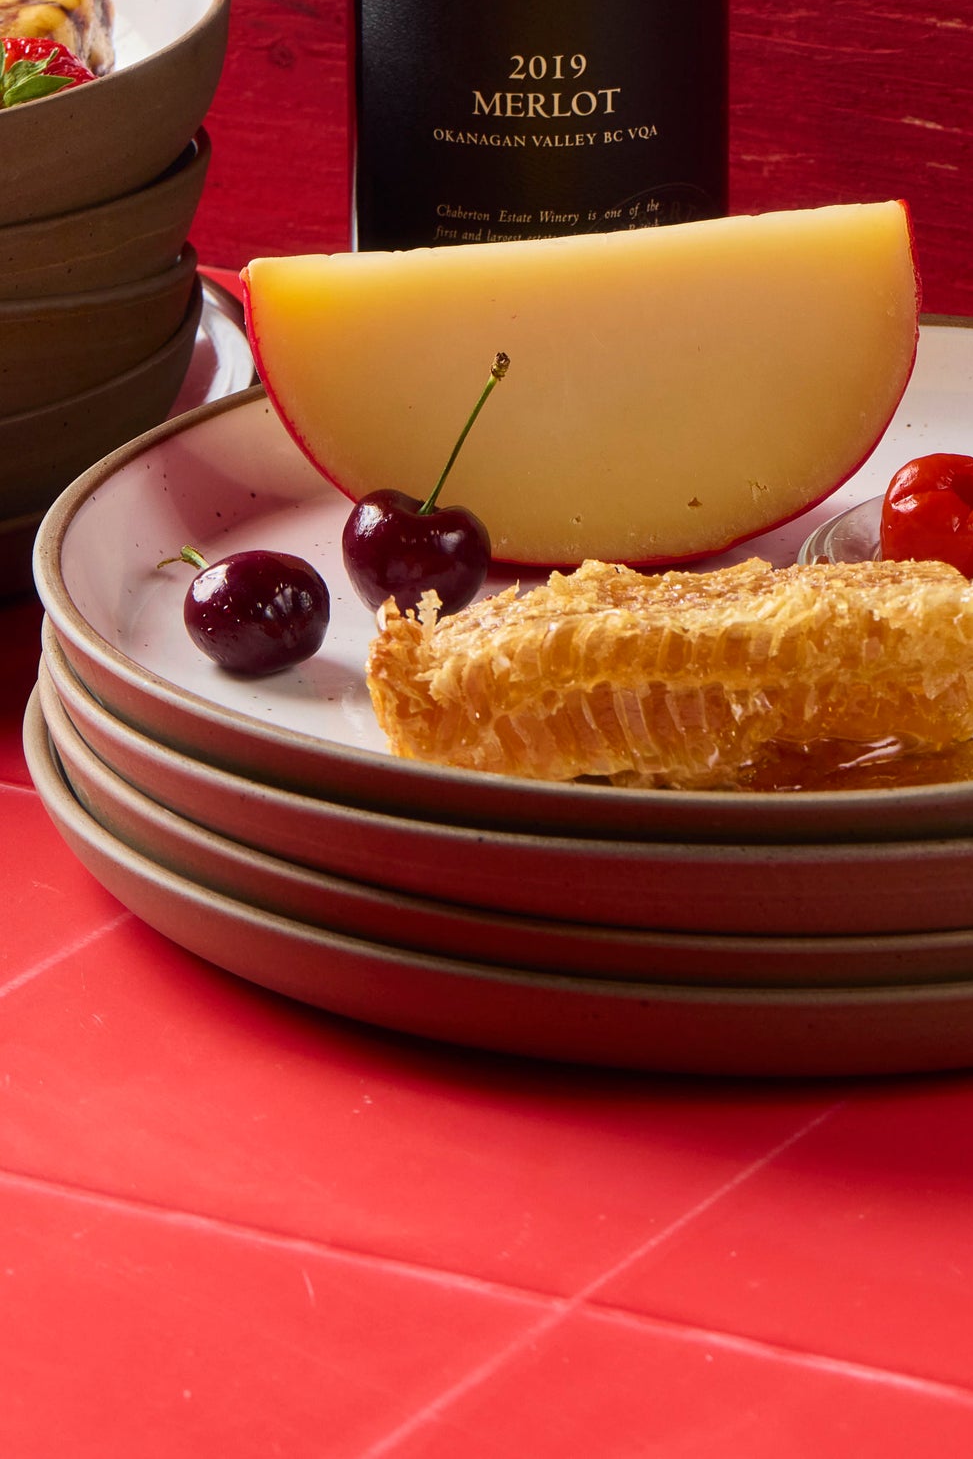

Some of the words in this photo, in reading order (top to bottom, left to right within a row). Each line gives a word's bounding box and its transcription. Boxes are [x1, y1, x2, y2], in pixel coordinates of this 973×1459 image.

[507, 53, 588, 81] 2019
[471, 87, 622, 119] MERLOT
[432, 128, 526, 148] OKANAGAN
[531, 132, 597, 147] VALLEY
[603, 130, 624, 144] BC
[627, 124, 658, 141] VQA
[435, 203, 491, 222] Chaberton
[497, 209, 532, 224] Estate
[539, 210, 580, 226] Winery
[587, 209, 598, 220] is
[604, 208, 623, 220] one
[628, 201, 642, 218] of
[646, 198, 661, 213] the
[432, 224, 458, 241] first
[461, 227, 482, 242] and
